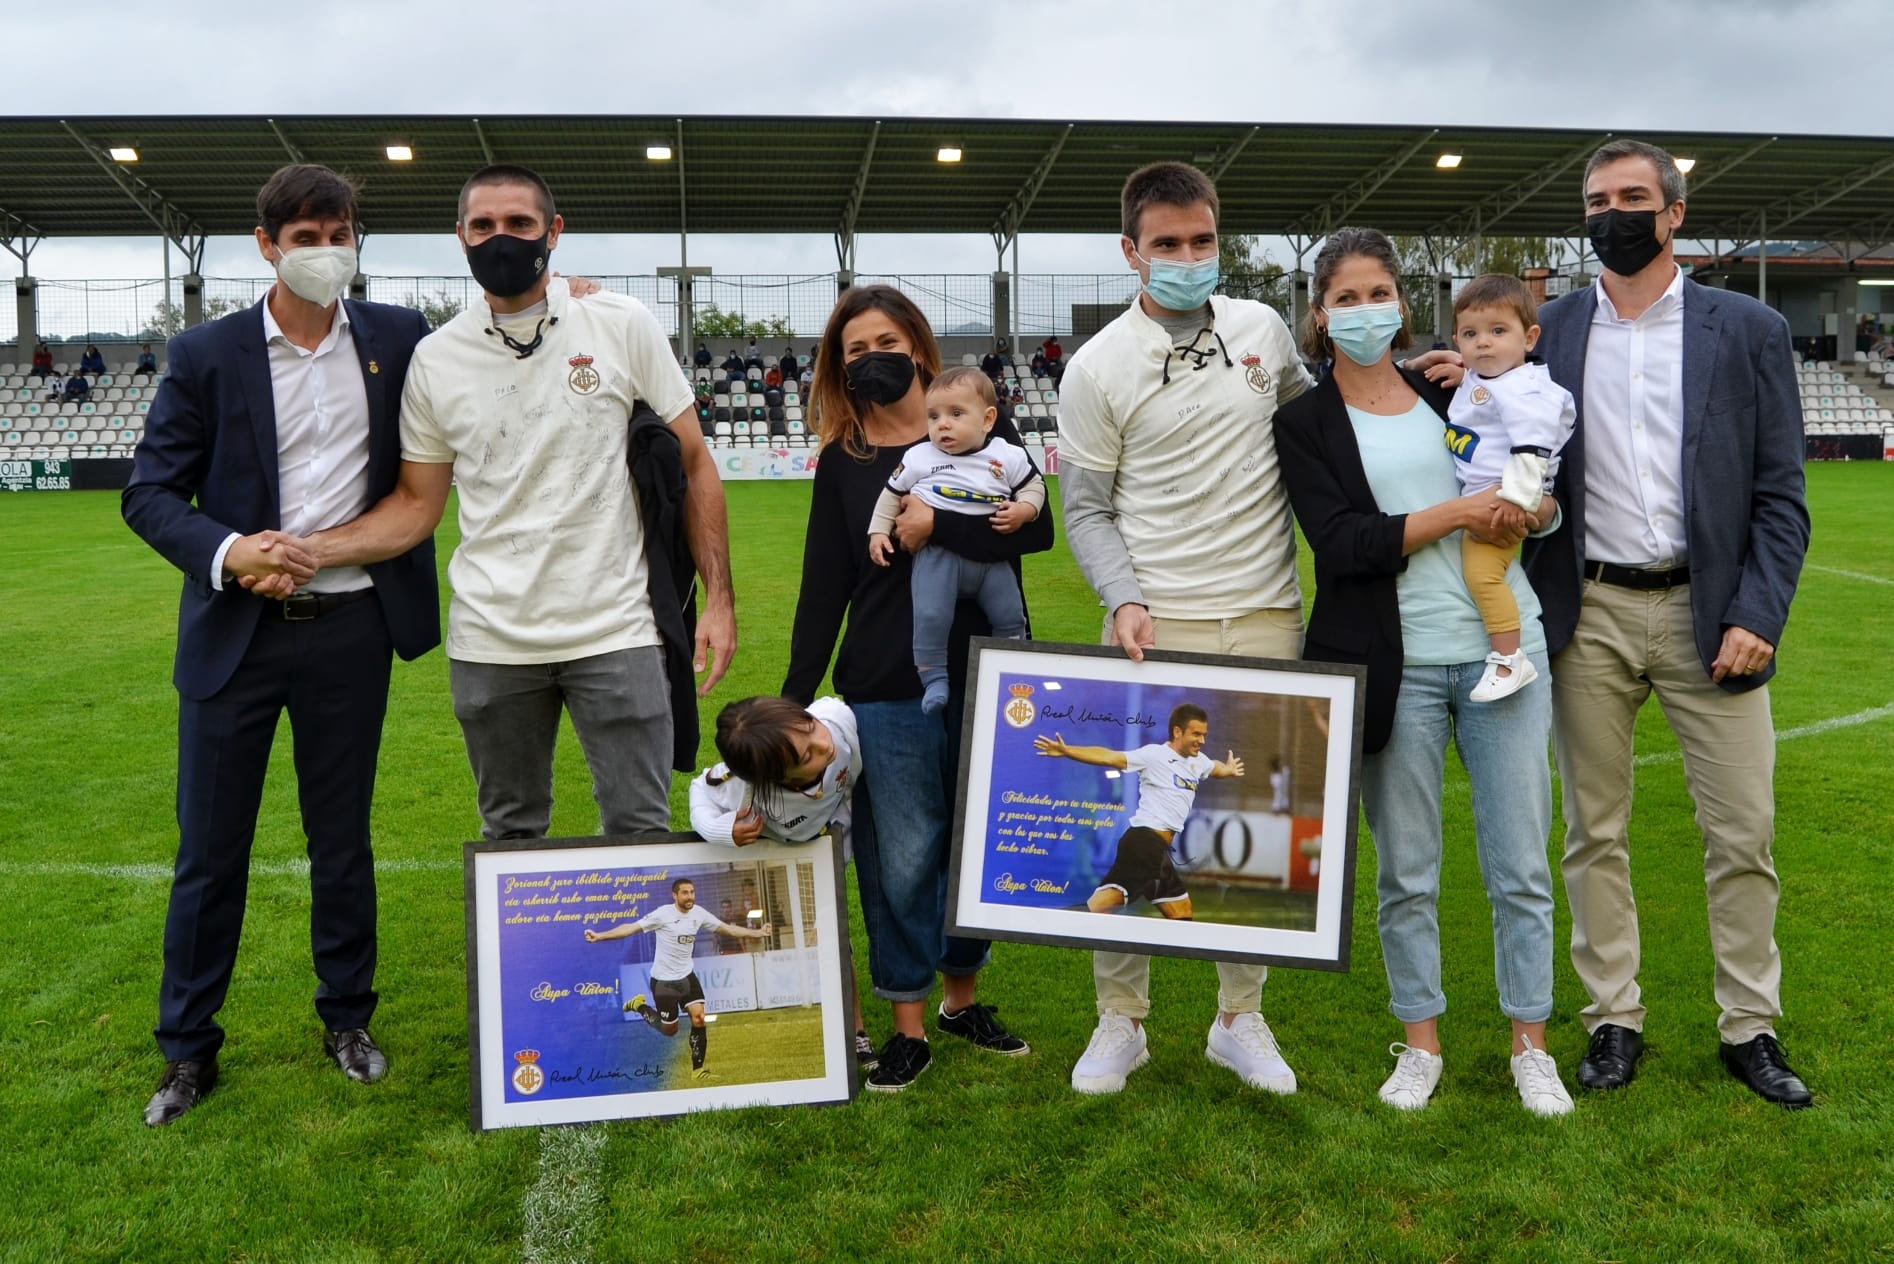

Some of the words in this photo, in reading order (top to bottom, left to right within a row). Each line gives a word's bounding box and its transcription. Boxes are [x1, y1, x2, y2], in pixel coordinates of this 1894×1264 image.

[1444, 425, 1473, 455] M
[0, 462, 28, 476] OLA
[44, 459, 61, 474] 943
[1001, 790, 1053, 806] Felicidades
[1051, 799, 1069, 810] por
[1081, 800, 1126, 812] trayectoria
[1006, 811, 1037, 823] gracias
[1035, 815, 1053, 825] por
[1054, 813, 1077, 824] todos
[1094, 816, 1115, 830] goles
[575, 873, 613, 886] ibilbide
[993, 872, 1028, 895] Aupa
[584, 894, 609, 903] eman
[505, 913, 533, 925] adore
[529, 981, 571, 1004] Aupa
